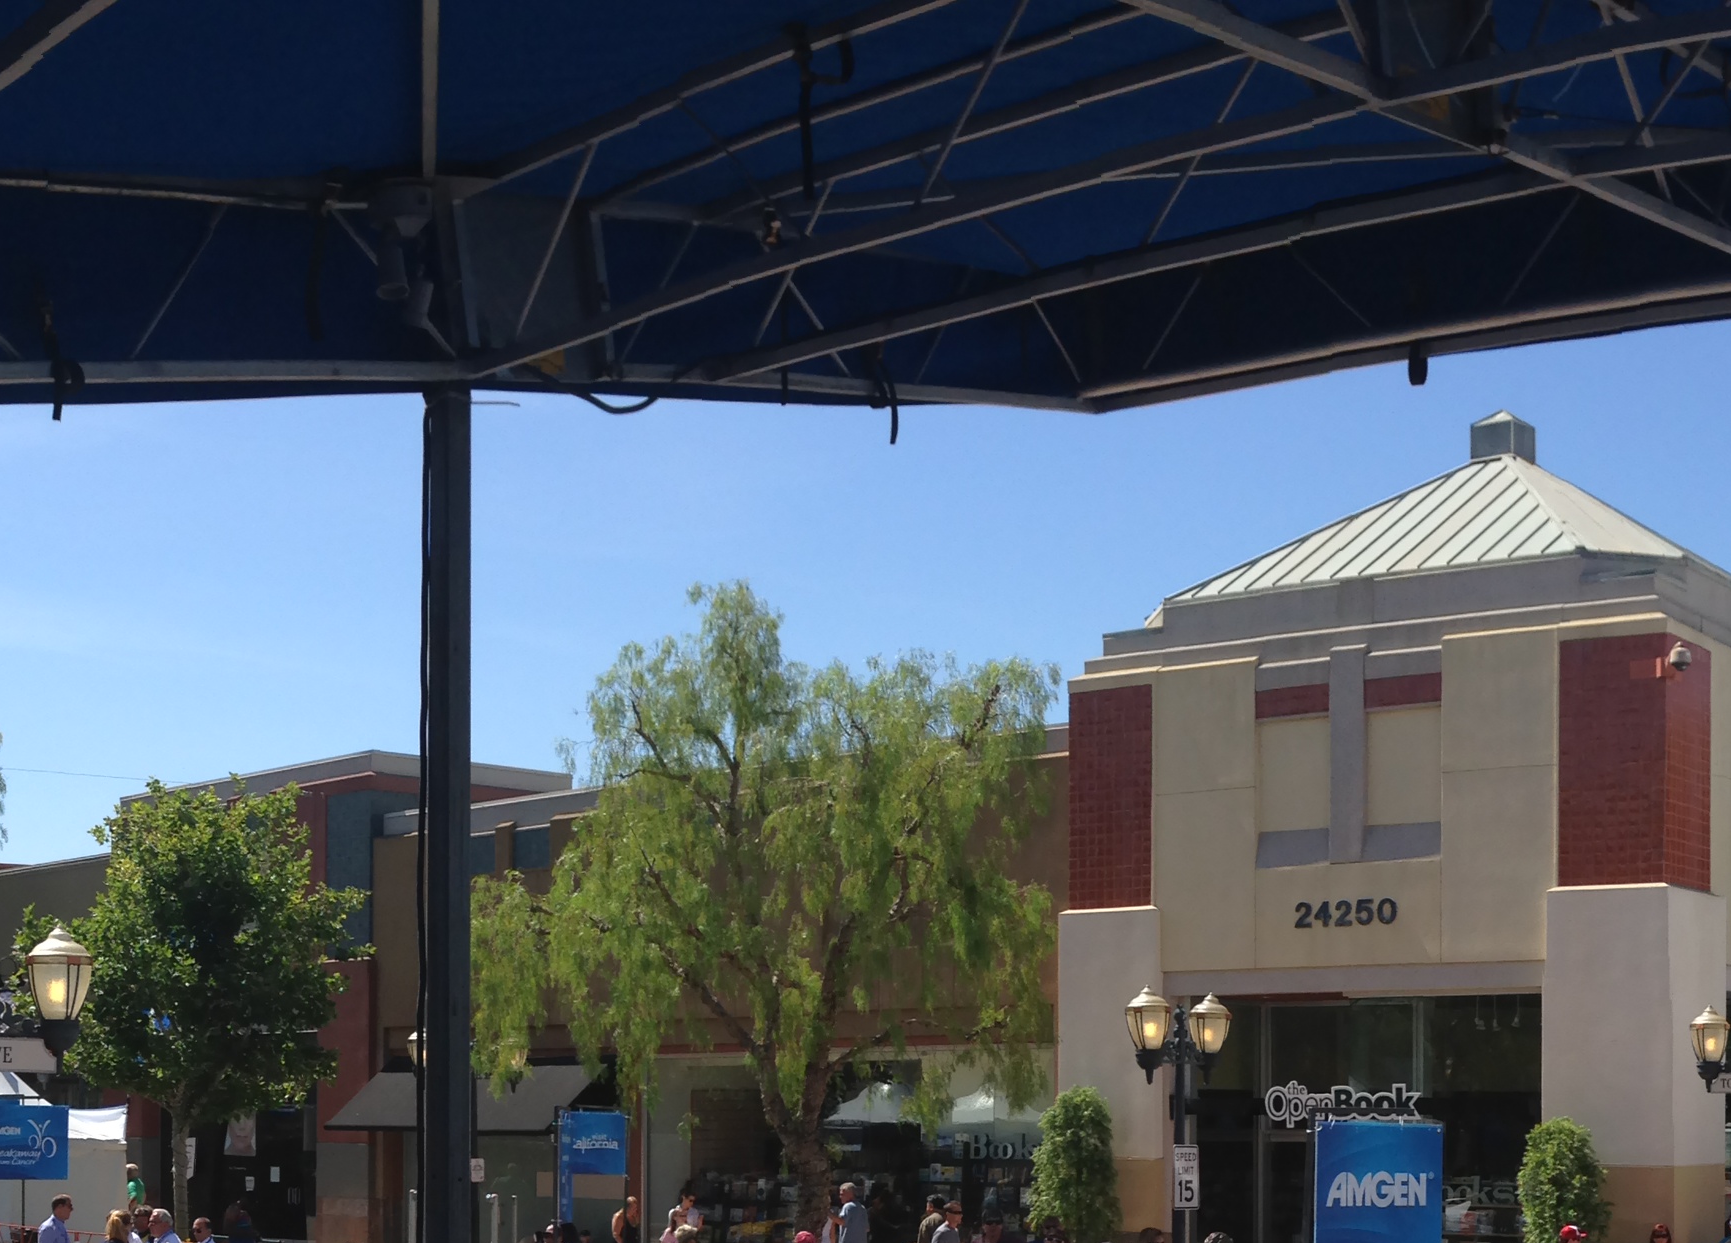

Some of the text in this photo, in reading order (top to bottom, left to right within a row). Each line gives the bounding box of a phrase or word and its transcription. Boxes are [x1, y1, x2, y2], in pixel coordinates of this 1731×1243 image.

[1294, 898, 1398, 929] 24250
[1287, 1082, 1306, 1097] the
[573, 1138, 619, 1154] alifornia
[11, 1158, 37, 1167] Cancer
[1176, 1152, 1196, 1162] SPEED
[1178, 1166, 1195, 1176] LIMIT
[1178, 1180, 1194, 1202] 15
[1326, 1171, 1427, 1208] AMGEN
